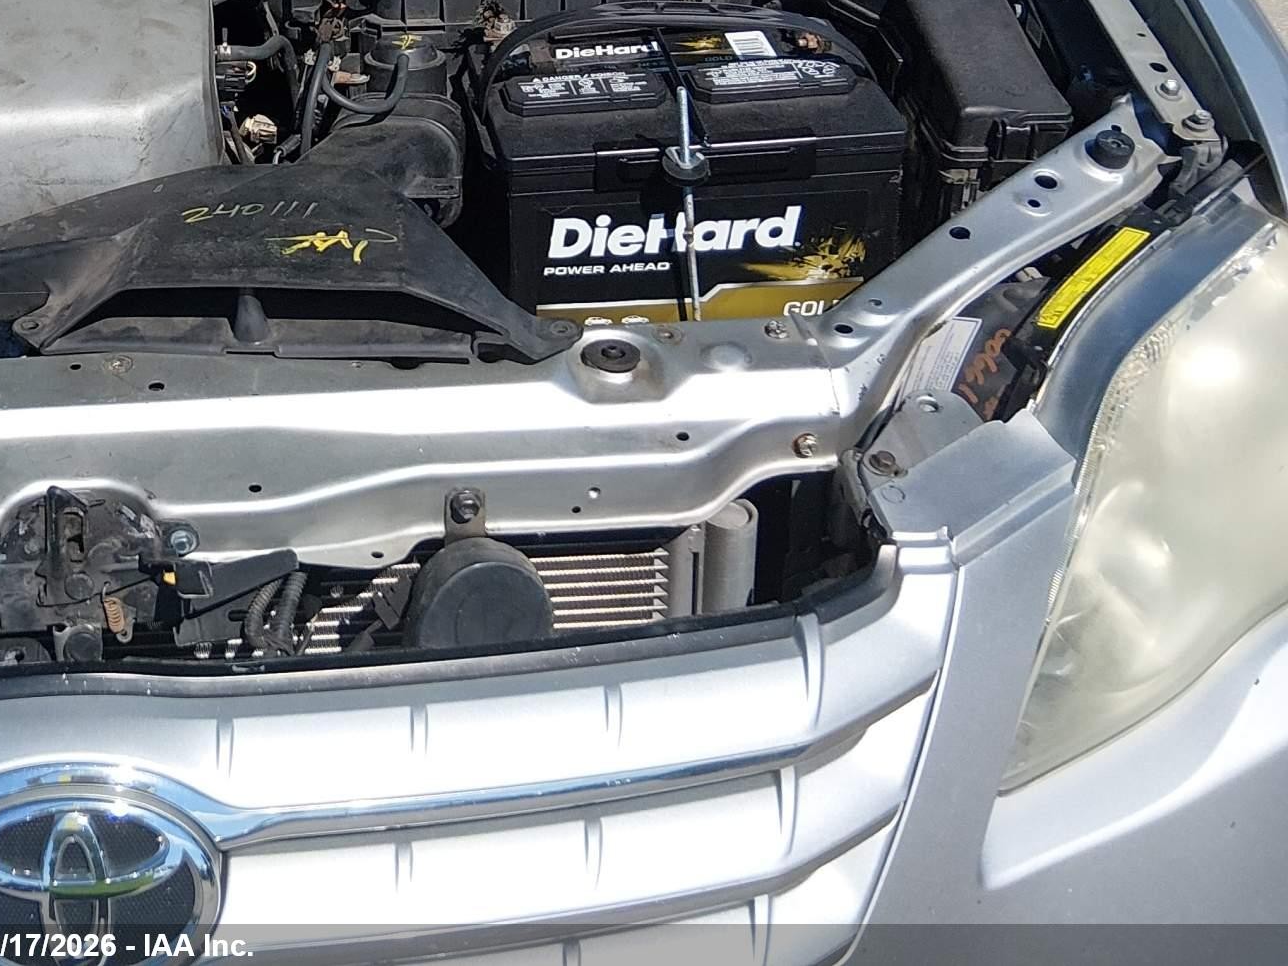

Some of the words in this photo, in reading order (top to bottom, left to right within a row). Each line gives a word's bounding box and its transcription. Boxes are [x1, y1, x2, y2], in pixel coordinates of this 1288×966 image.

[548, 205, 802, 258] DieHard
[543, 265, 605, 277] POWER
[609, 262, 670, 273] AHEAD
